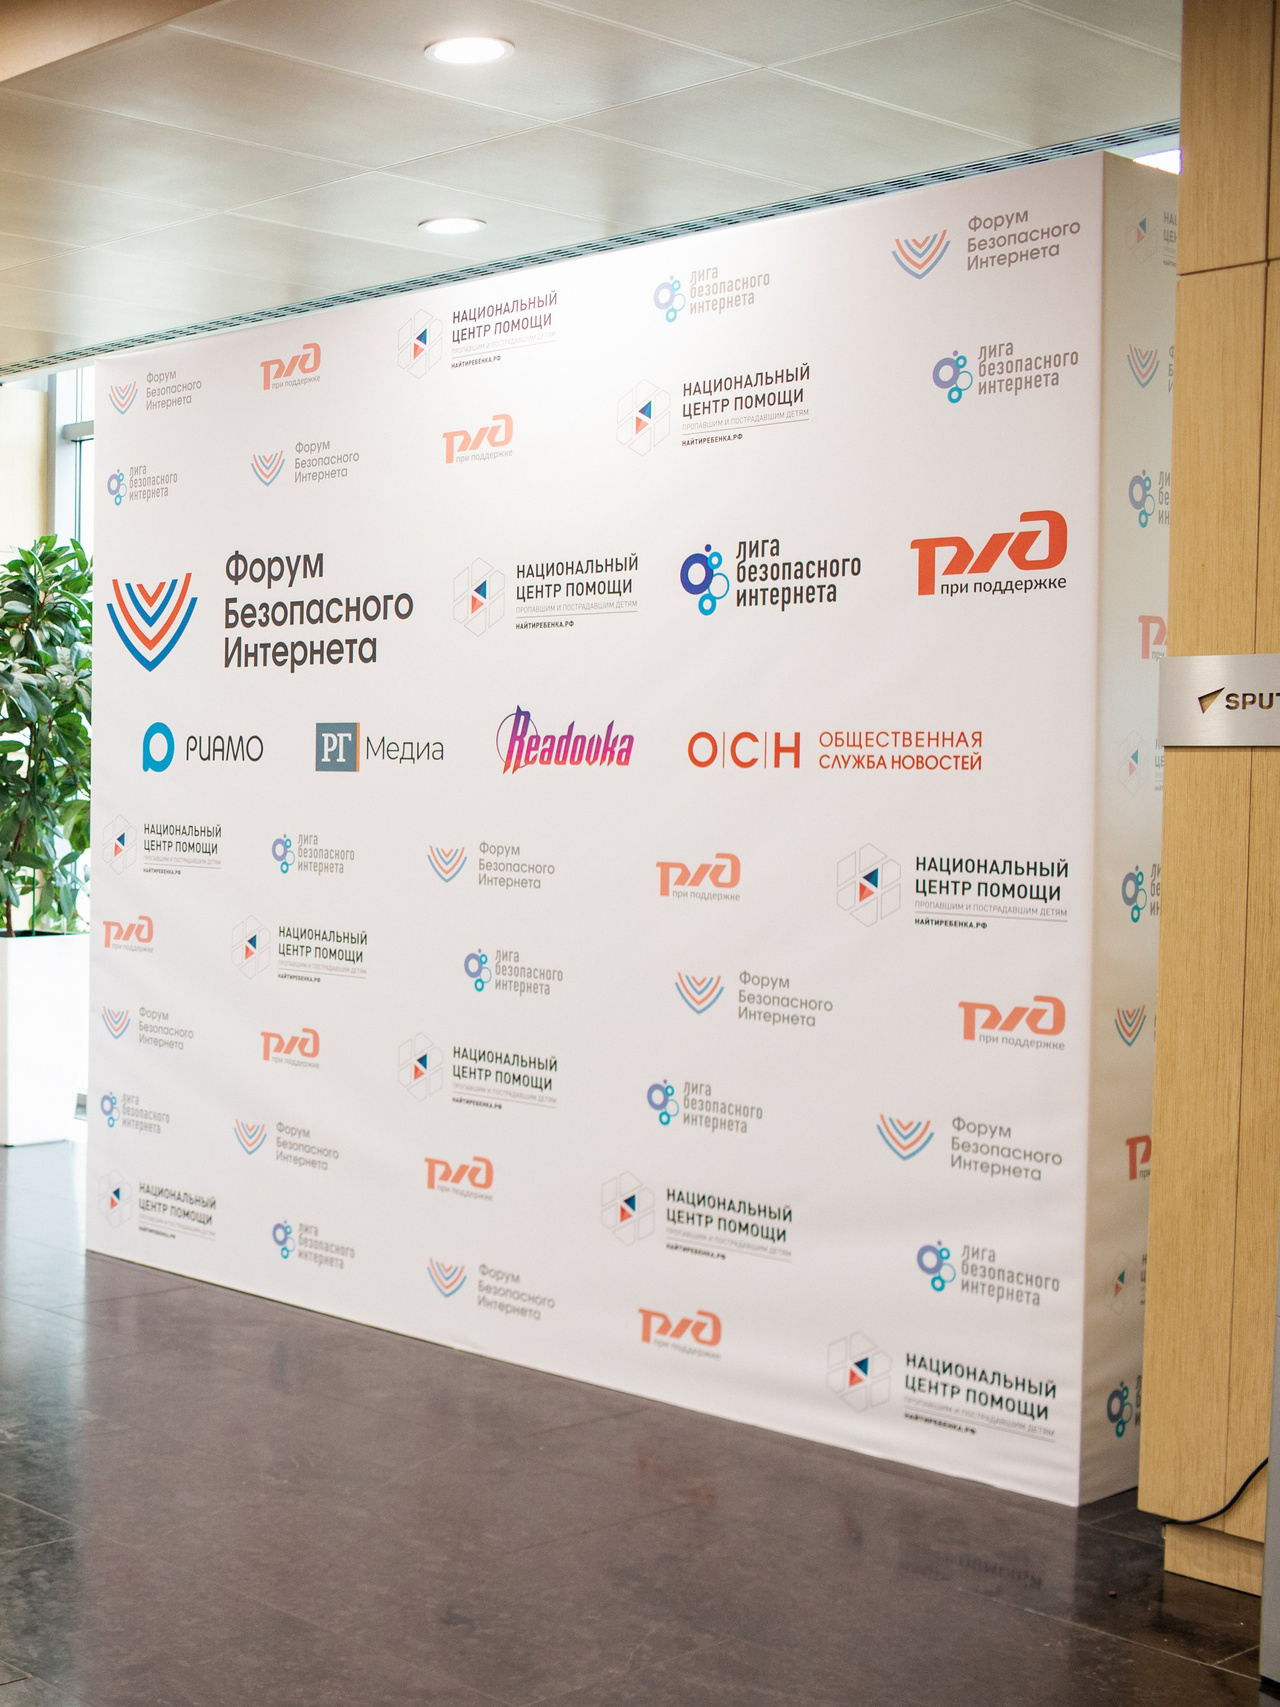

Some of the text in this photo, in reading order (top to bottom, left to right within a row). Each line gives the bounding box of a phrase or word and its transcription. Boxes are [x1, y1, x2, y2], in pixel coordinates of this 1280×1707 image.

[967, 210, 1028, 232] Форум
[967, 221, 1081, 253] Безопасного
[967, 244, 1060, 271] Интернета
[689, 266, 718, 284] лига
[689, 272, 770, 299] безопасного
[452, 289, 557, 324] НАЦИОНАЛЬНЫЙ
[690, 291, 755, 315] интернета
[452, 312, 552, 344] ЦЕНТР ПОМОЩИ
[977, 341, 1013, 362] лига
[978, 350, 1079, 377] безопасного
[146, 370, 177, 384] Форум
[683, 362, 810, 396] НАЦИОНАЛЬНЫЙ
[978, 371, 1059, 396] интернета
[145, 380, 202, 398] Безопасного
[146, 394, 192, 411] Интернета
[682, 388, 803, 420] ЦЕНТР ПОМОЩИ
[294, 440, 330, 454] Форум
[128, 464, 147, 478] лига
[294, 452, 360, 470] Безопасного
[129, 472, 178, 489] безопасного
[294, 467, 348, 483] Интернета
[128, 486, 168, 502] интернета
[735, 538, 780, 561] лига
[225, 549, 324, 590] Форум
[516, 552, 638, 580] НАЦИОНАЛЬНЫЙ
[736, 556, 861, 583] безопасного
[516, 578, 632, 602] ЦЕНТР ПОМОЩИ
[736, 583, 837, 612] интернета
[940, 577, 1067, 597] при поддержке
[224, 592, 414, 629] Безопасного
[224, 636, 377, 673] Интернета
[186, 735, 264, 762] РИАМО
[321, 733, 445, 764] РГ Медиа
[503, 704, 635, 775] Readovka
[819, 731, 983, 750] ОБЩЕСТВЕННАЯ
[819, 752, 982, 771] СЛУЖБА НОВОСТЕЙ
[143, 823, 222, 838] НАЦИОНАЛЬНЫЙ
[297, 834, 318, 846] лига
[143, 839, 218, 856] ЦЕНТР ПОМОЩИ
[297, 843, 355, 861] безопасного
[478, 840, 520, 858] Форум
[297, 860, 344, 876] интернета
[478, 857, 555, 875] Безопасного
[915, 856, 1068, 878] НАЦИОНАЛЬНЫЙ
[478, 872, 541, 890] Интернета
[915, 878, 1060, 903] ЦЕНТР ПОМОЩИ
[278, 926, 367, 945] НАЦИОНАЛЬНЫЙ
[278, 943, 363, 964] ЦЕНТР ПОМОЩИ
[494, 949, 520, 963] лига
[494, 960, 564, 982] безопасного
[738, 970, 790, 990] Форум
[494, 978, 550, 996] интернета
[738, 989, 833, 1012] Безопасного
[738, 1005, 816, 1027] Интернета
[452, 1045, 557, 1072] НАЦИОНАЛЬНЫЙ
[452, 1064, 552, 1092] ЦЕНТР ПОМОЩИ
[682, 1080, 712, 1097] лига
[682, 1092, 763, 1120] безопасного
[682, 1112, 747, 1134] интернета
[951, 1115, 1011, 1139] Форум
[950, 1135, 1063, 1166] Безопасного
[950, 1153, 1042, 1181] Интернета
[666, 1188, 792, 1222] НАЦИОНАЛЬНЫЙ
[666, 1208, 714, 1228] ЦЕНТР
[717, 1216, 786, 1244] ПОМОЩИ
[961, 1244, 996, 1263] лига
[961, 1256, 1060, 1292] безопасного
[960, 1278, 1040, 1306] интернета
[906, 1352, 1056, 1399] НАЦИОНАЛЬНЫЙ
[904, 1374, 961, 1399] ЦЕНТР
[965, 1388, 1048, 1421] ПОМОЩИ
